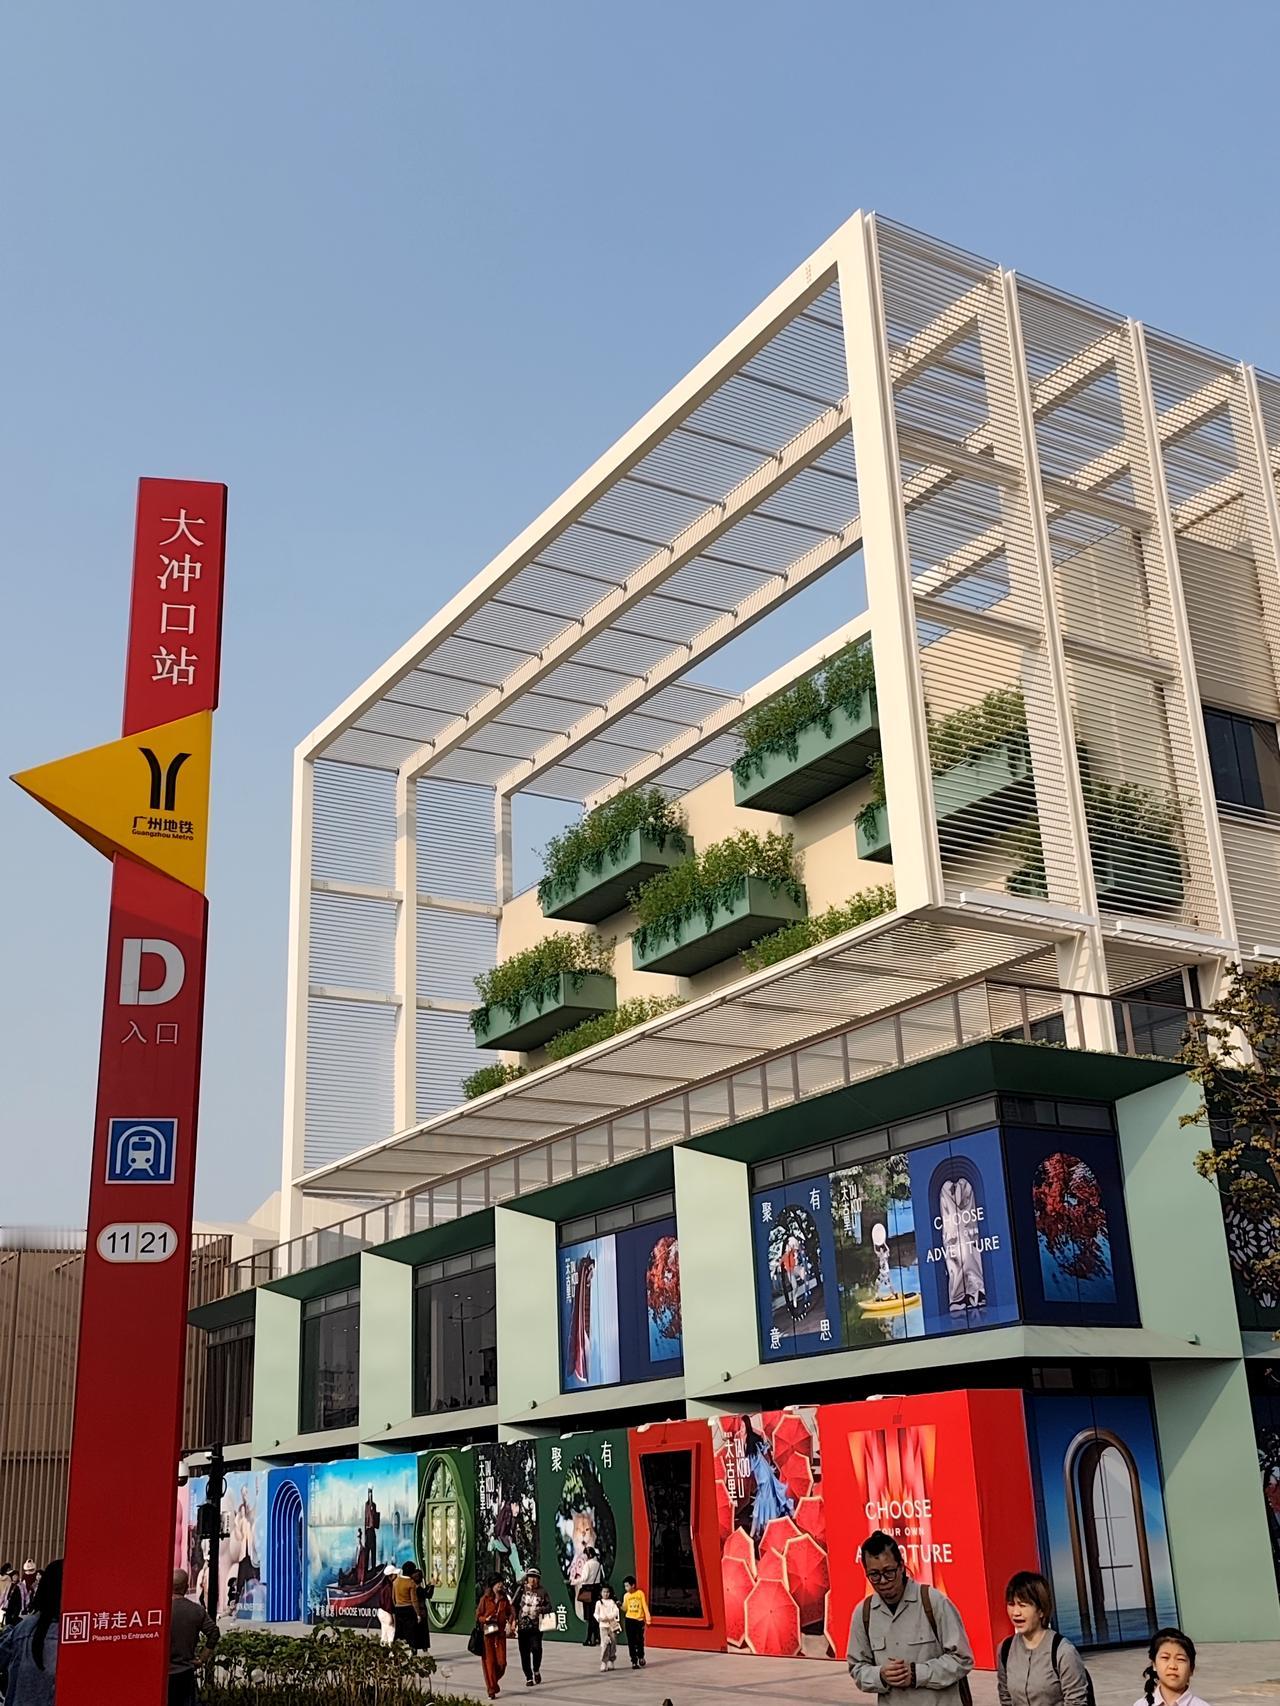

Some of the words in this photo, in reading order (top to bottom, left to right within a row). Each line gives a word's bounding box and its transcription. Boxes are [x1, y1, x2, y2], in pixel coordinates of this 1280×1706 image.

[152, 508, 206, 686] 大冲口站
[132, 816, 193, 834] 广州地铁
[132, 829, 171, 838] Guangzhou
[172, 833, 194, 841] Metro
[119, 938, 186, 1005] D
[121, 1021, 178, 1045] 入口
[809, 1188, 821, 1211] 有
[761, 1202, 773, 1223] 聚
[933, 1207, 985, 1230] CHOOSE
[107, 1232, 131, 1254] 11
[140, 1231, 169, 1253] 21
[769, 1327, 781, 1350] 意
[819, 1319, 832, 1341] 思
[551, 1447, 562, 1473] 聚
[601, 1440, 612, 1469] 有
[725, 1439, 738, 1499] 太古里
[865, 1500, 932, 1520] CHOOSE
[904, 1527, 925, 1537] OWN
[92, 1610, 162, 1630] 请走A口
[556, 1604, 568, 1632] 意
[128, 1632, 153, 1640] Entrance
